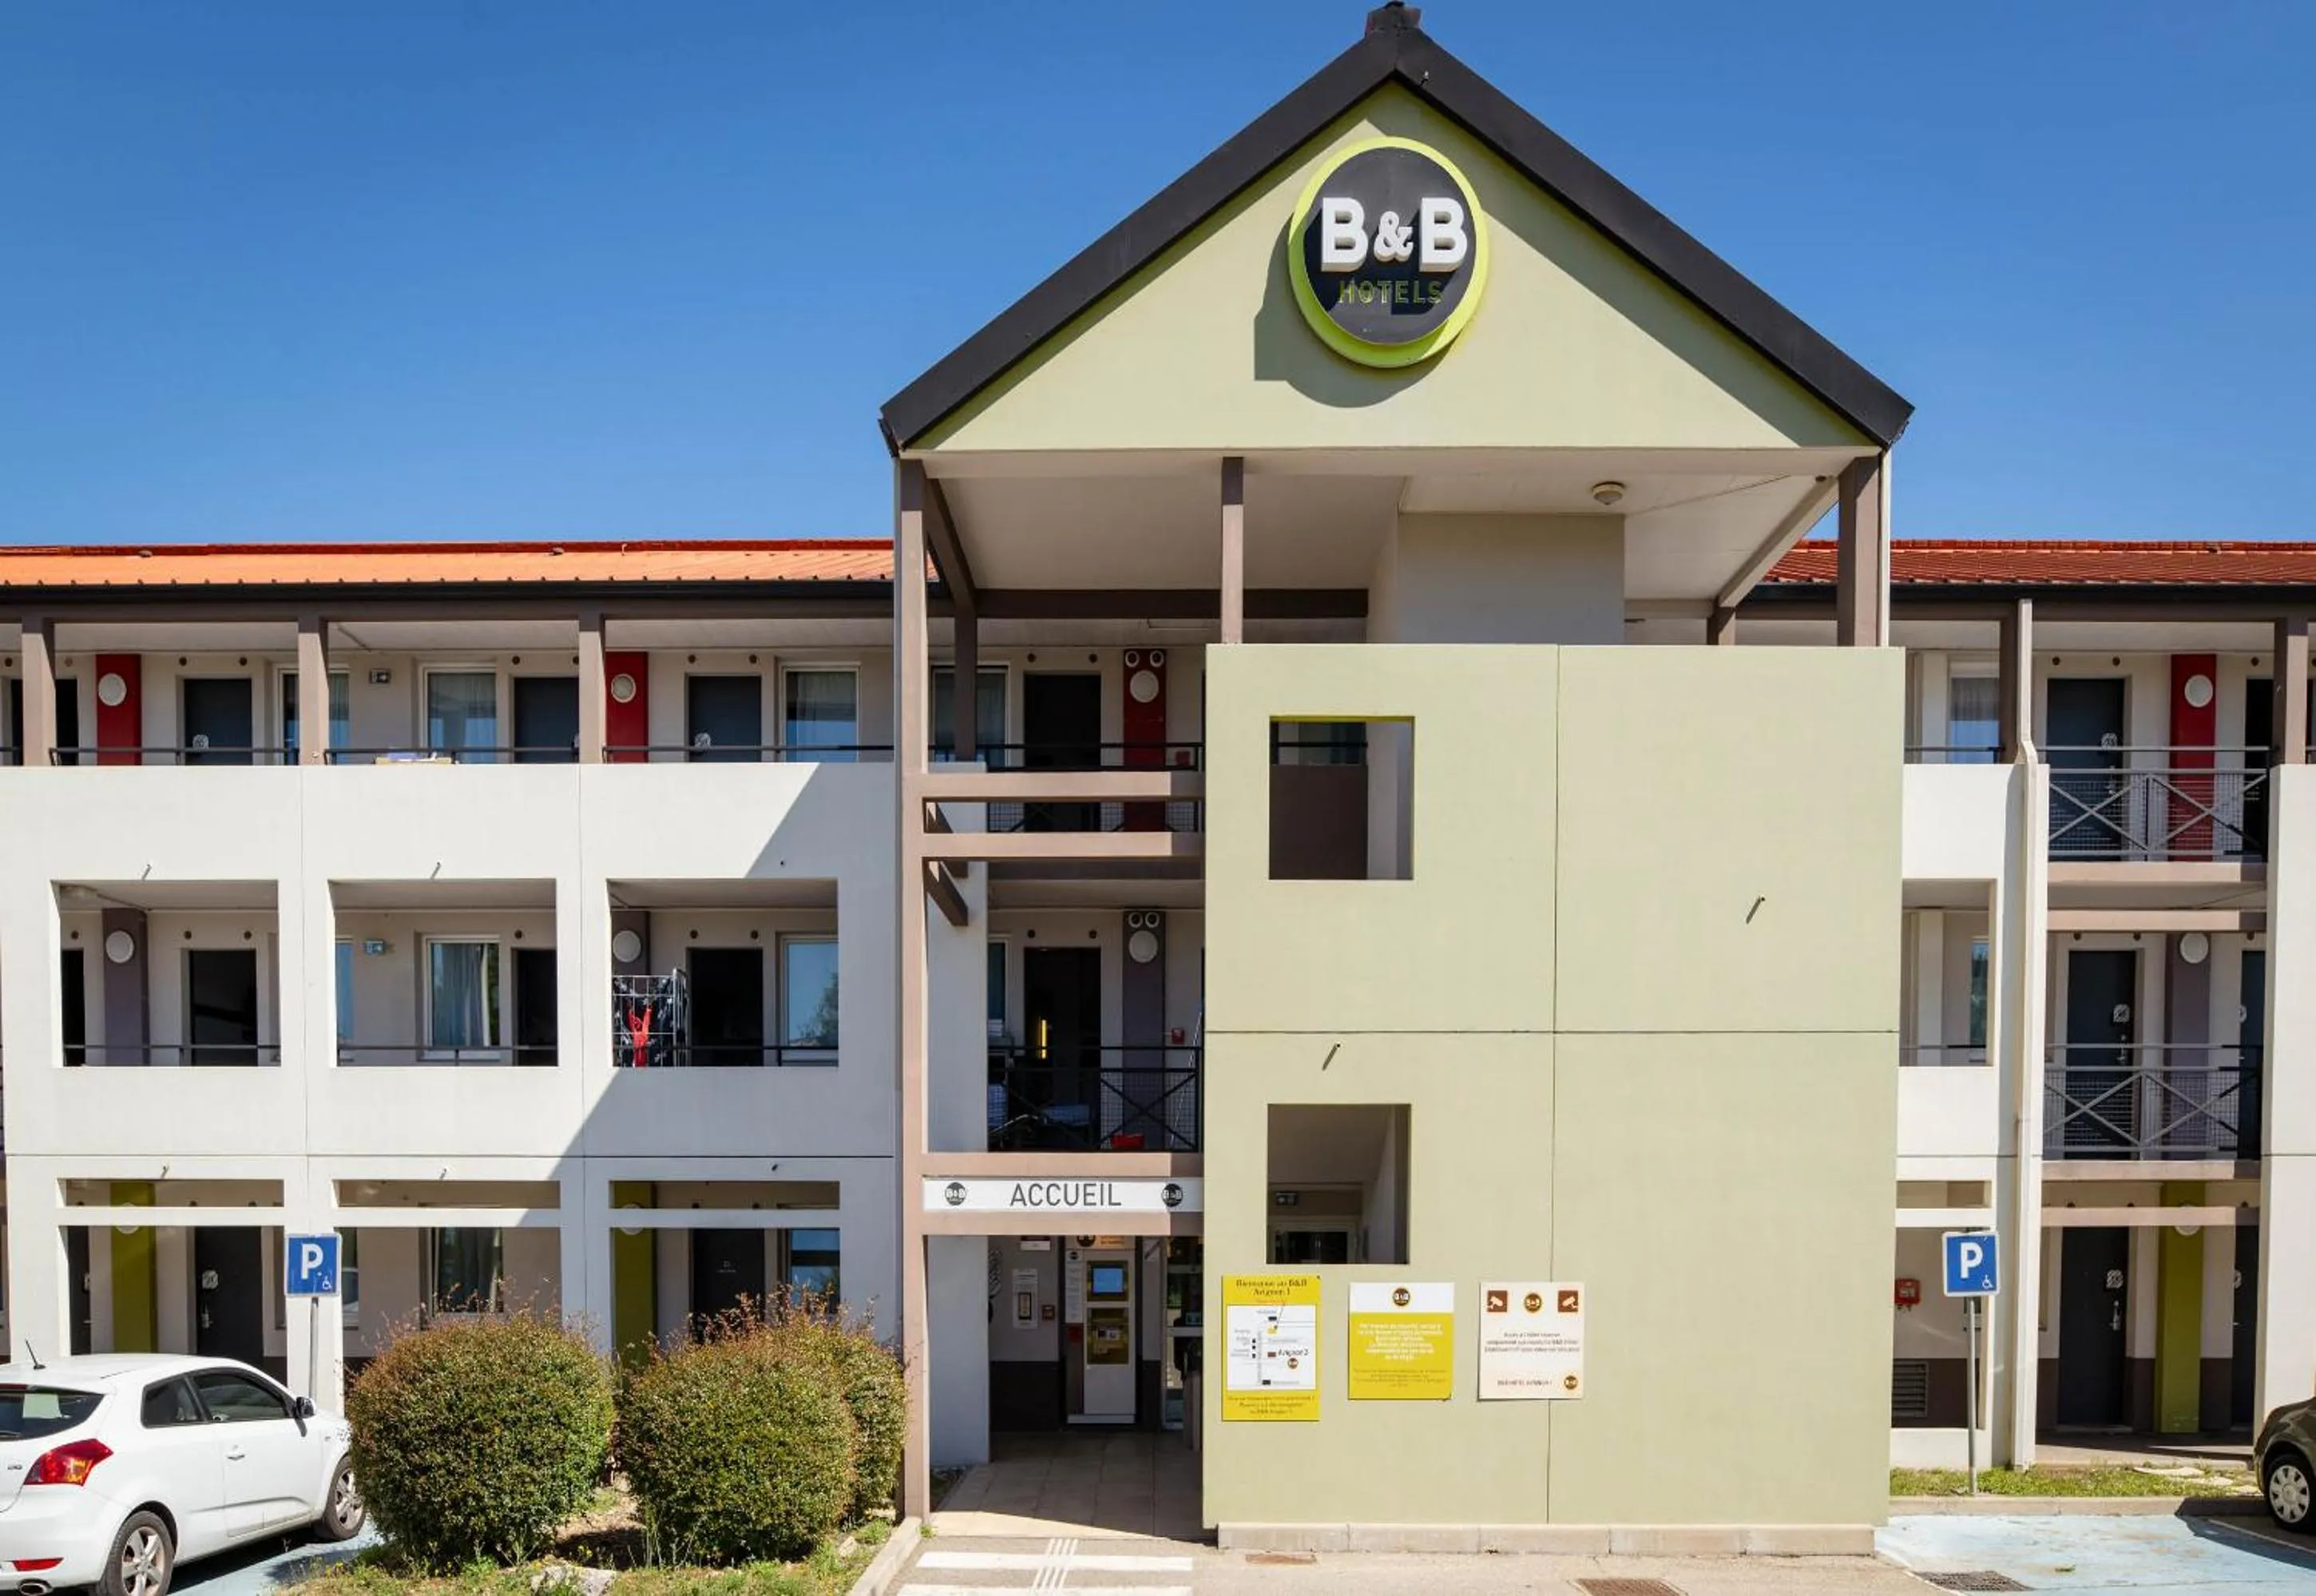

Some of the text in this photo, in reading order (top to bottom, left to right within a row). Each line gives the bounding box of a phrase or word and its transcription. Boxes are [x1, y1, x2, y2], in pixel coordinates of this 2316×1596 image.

[1321, 196, 1468, 272] B&B
[1338, 279, 1445, 304] HOTELS
[1009, 1182, 1122, 1206] ACCUEIL
[301, 1243, 323, 1280] P
[1961, 1242, 1983, 1278] P
